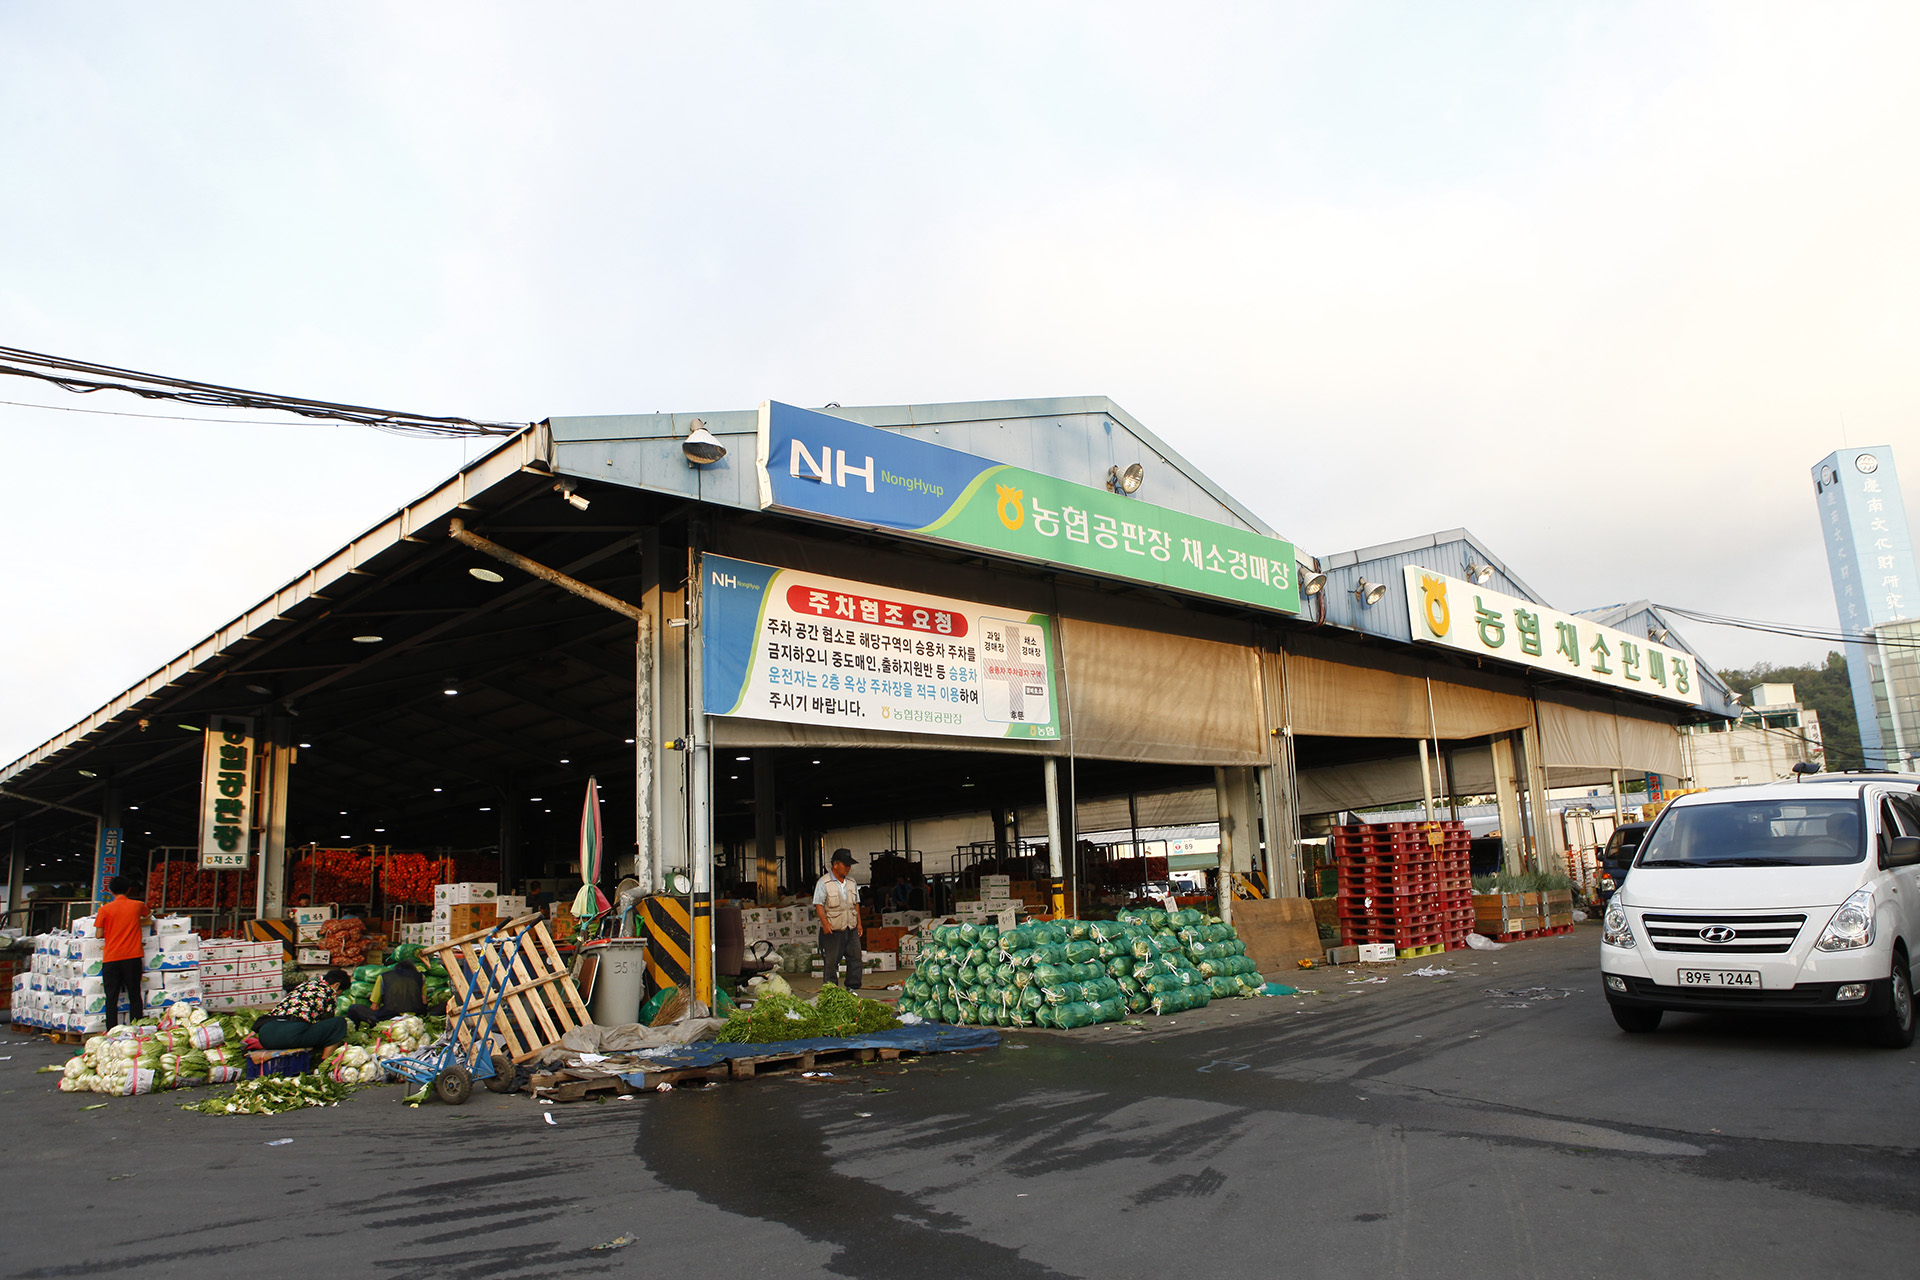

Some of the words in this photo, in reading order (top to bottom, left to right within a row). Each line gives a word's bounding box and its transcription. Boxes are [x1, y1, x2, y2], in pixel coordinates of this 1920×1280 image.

[789, 438, 875, 494] NH
[881, 470, 944, 497] NongHyup
[1032, 496, 1172, 563] 농협공판장
[1180, 536, 1290, 591] 채소경매장
[712, 571, 737, 589] NH
[808, 590, 904, 626] 주차협조
[912, 609, 953, 634] 요청
[767, 618, 792, 638] 주차
[795, 621, 819, 642] 공간
[822, 625, 857, 646] 협소로
[859, 632, 912, 655] 해당구역의
[915, 637, 945, 659] 승용차
[948, 644, 976, 662] 주차를
[987, 631, 1001, 641] 과일
[1024, 636, 1037, 646] 채소
[1472, 594, 1690, 695] 농협채소판매장
[984, 641, 1005, 653] 경매장
[1021, 646, 1041, 657] 경매장
[768, 642, 828, 666] 금지하오니
[936, 664, 946, 680] 등
[949, 665, 978, 684] 승용차
[768, 666, 818, 689] 운전자는
[821, 673, 840, 692] 2층
[844, 675, 867, 694] 옥상
[870, 678, 913, 698] 주차장을
[916, 683, 937, 701] 적극
[940, 686, 979, 705] 이용하여
[769, 692, 808, 713] 주시기
[812, 696, 866, 718] 바랍니다.
[893, 708, 963, 725] 농협창원공판장
[1010, 711, 1025, 720] 후문
[1037, 726, 1055, 736] 농협
[213, 718, 248, 852] 농협공판장
[104, 829, 119, 856] 쓰레기
[1184, 843, 1194, 851] 89
[213, 855, 243, 865] 채소동
[613, 961, 628, 974] 35
[1685, 971, 1711, 984] 89두
[1717, 972, 1753, 986] 1244
